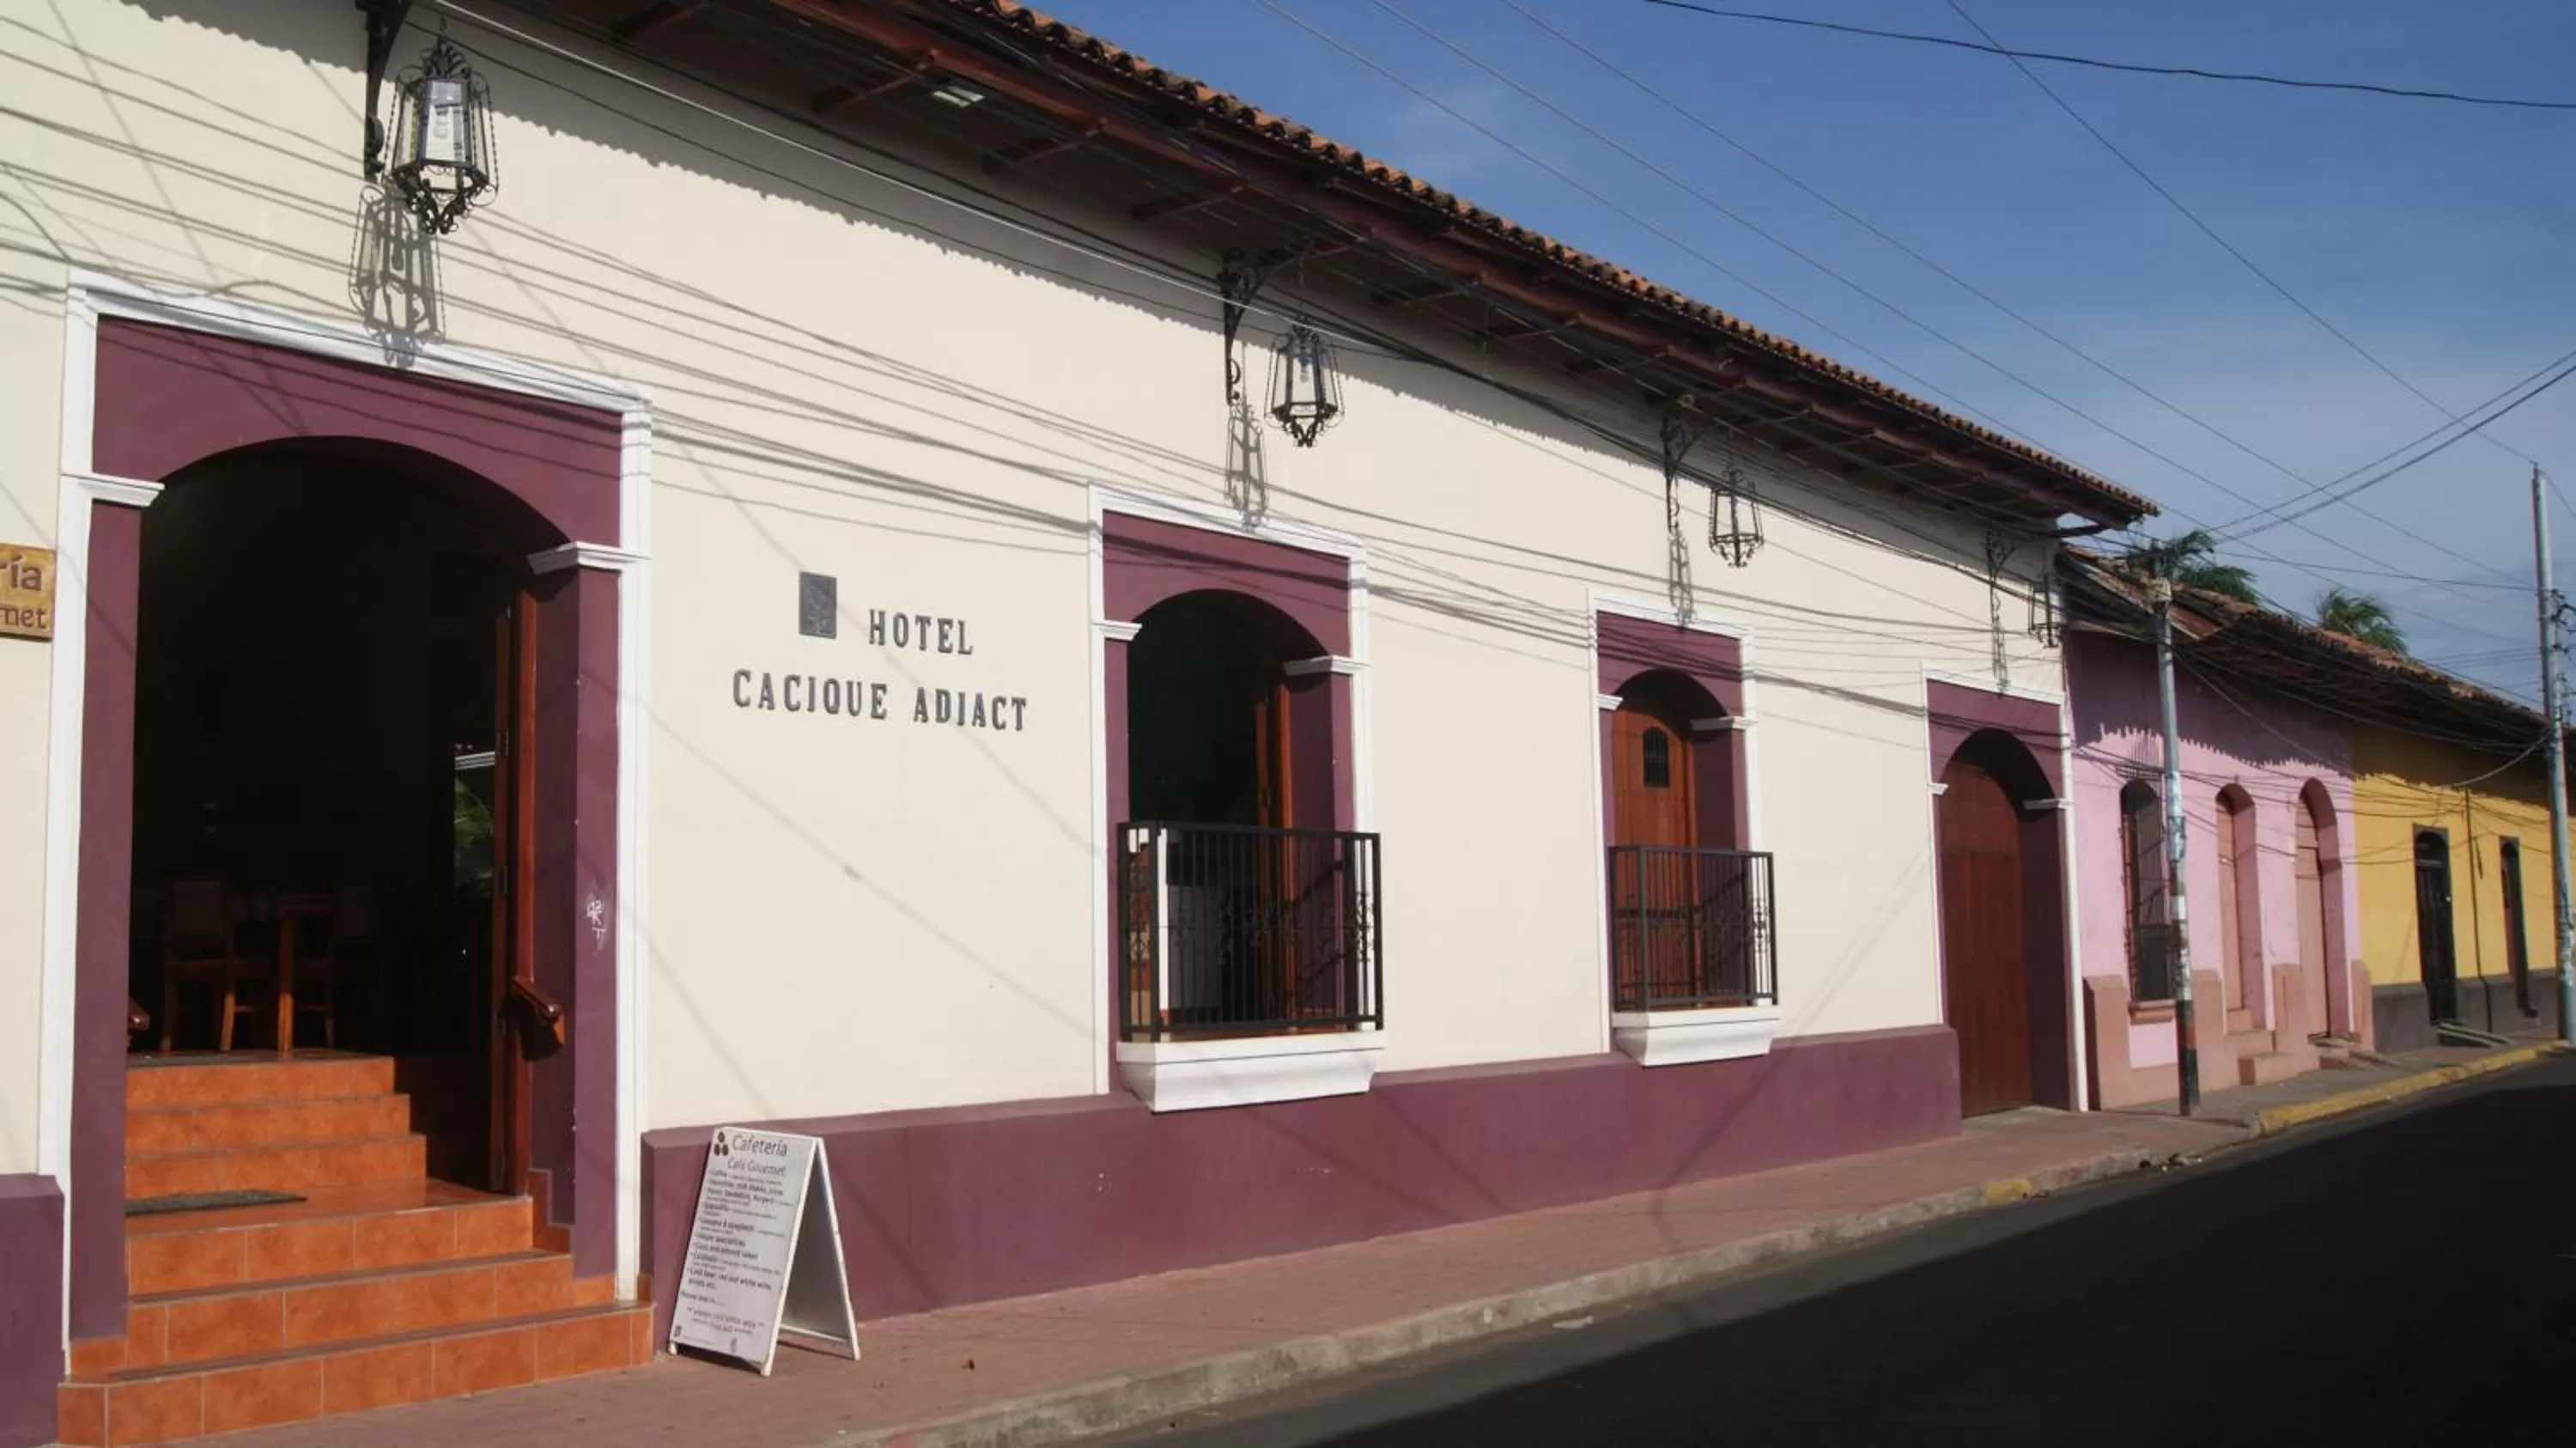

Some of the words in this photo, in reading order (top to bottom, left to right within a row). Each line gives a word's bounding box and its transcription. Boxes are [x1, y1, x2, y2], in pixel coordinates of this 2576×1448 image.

[868, 608, 974, 655] HOTEL
[732, 668, 888, 720] CACIQUE
[914, 686, 1027, 731] ADIACT
